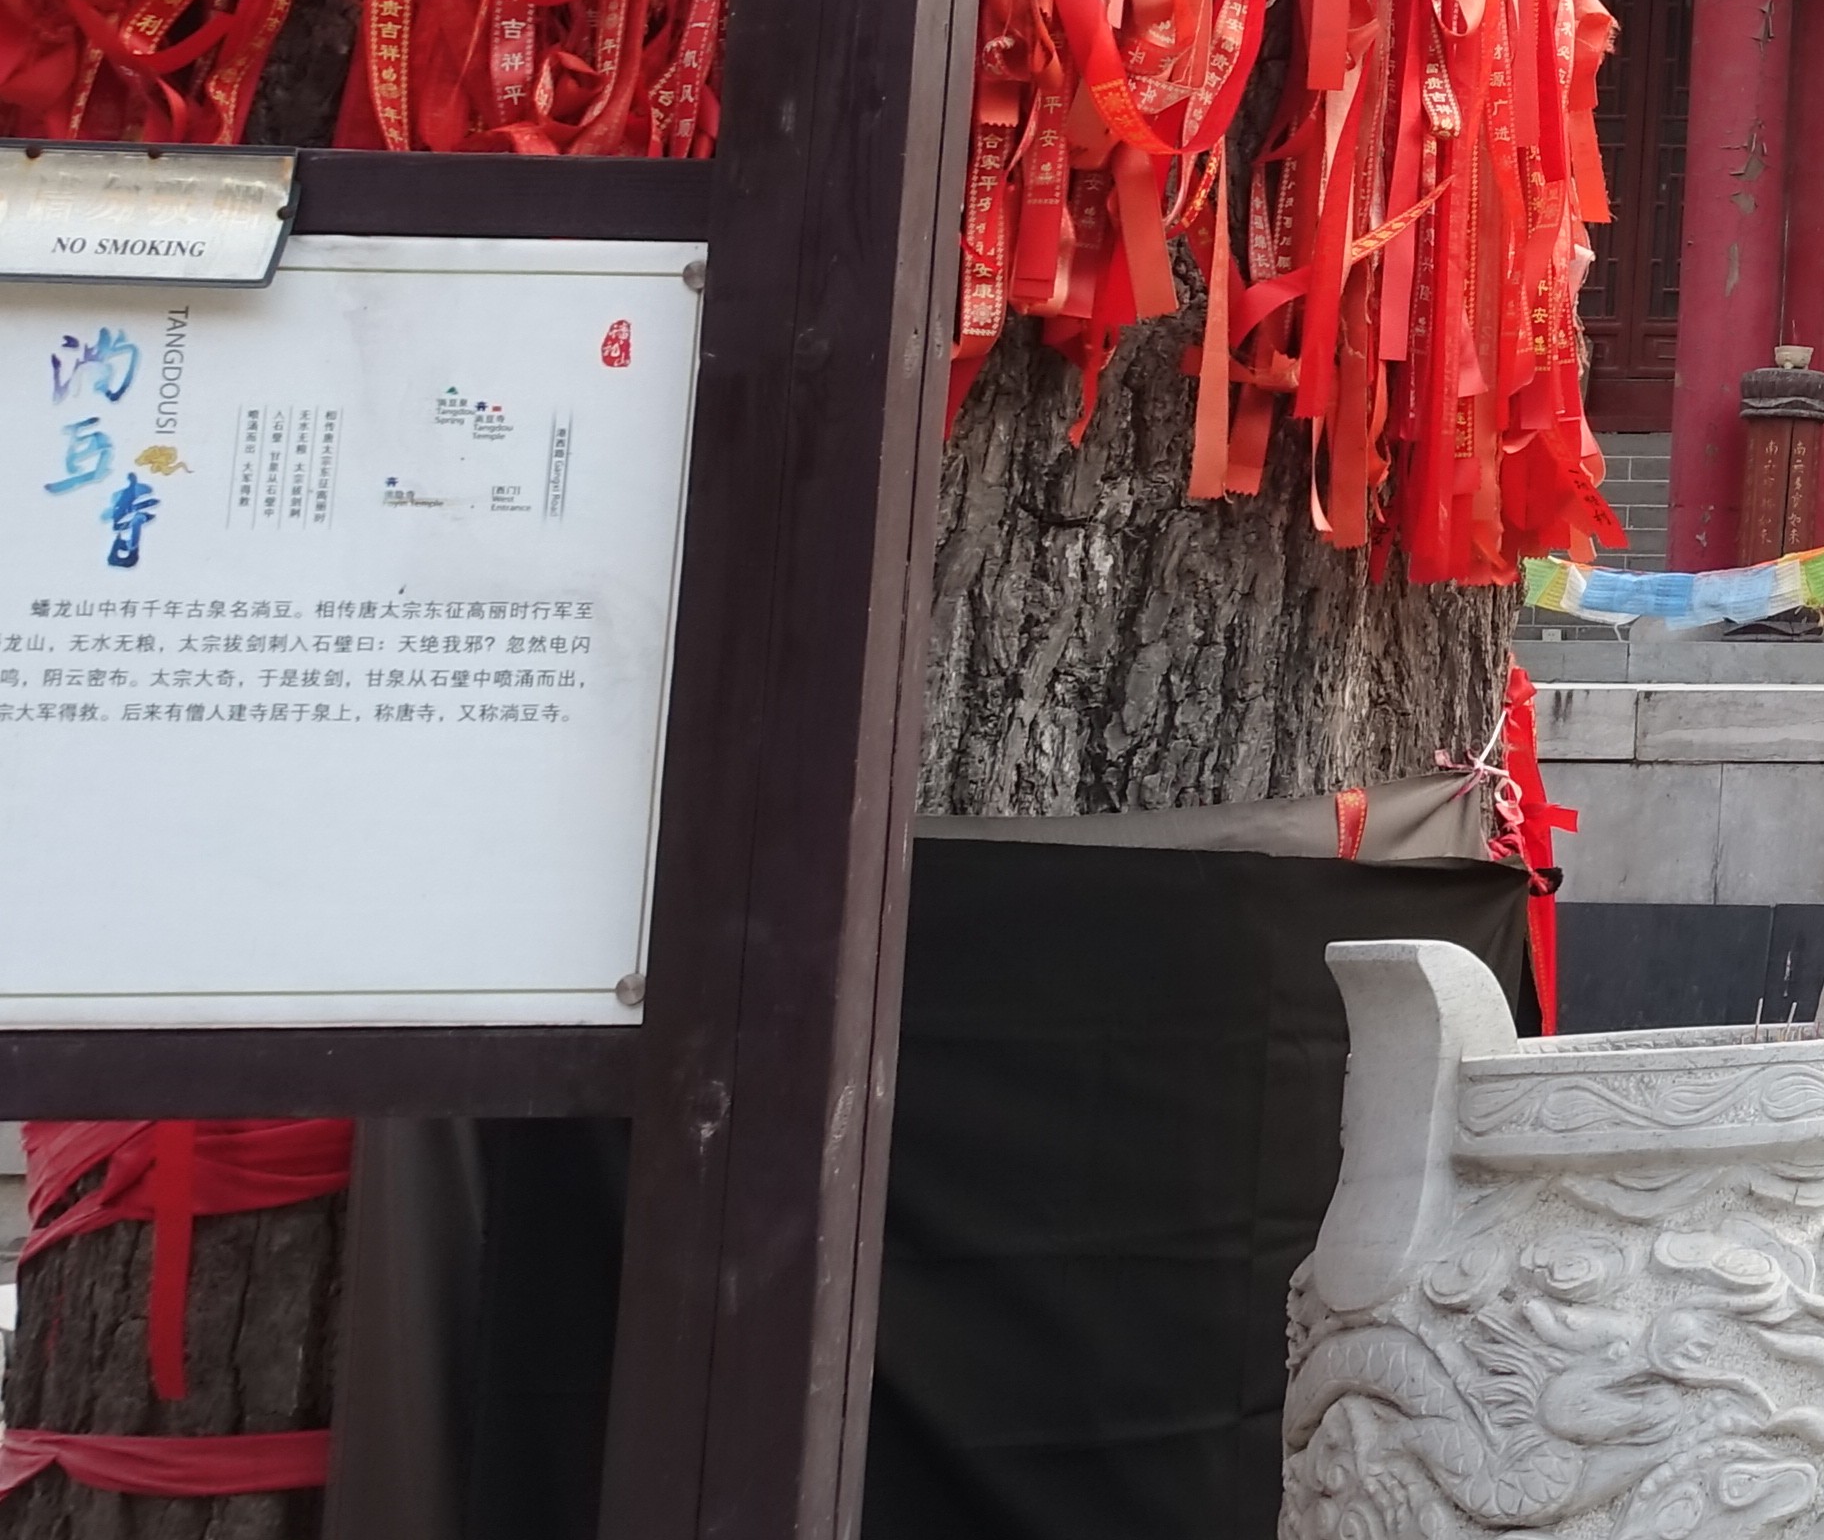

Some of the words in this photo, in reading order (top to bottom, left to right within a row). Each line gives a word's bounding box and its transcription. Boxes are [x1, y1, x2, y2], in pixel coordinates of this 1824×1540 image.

[52, 237, 87, 254] NO
[94, 238, 206, 258] SMOKING
[155, 305, 189, 435] TANGDOUSI
[272, 410, 285, 443] 入石壁
[296, 409, 312, 455] 无水无粮
[239, 461, 253, 507] 大军得救
[264, 451, 281, 518] 甘泉从石壁中
[289, 461, 305, 518] 太宗拔剑刺
[314, 410, 338, 523] 相传唐太宗东征高丽时
[31, 598, 594, 621] 蟠龙山中有千年古泉名淌豆。相传唐太宗东征高丽时行军至
